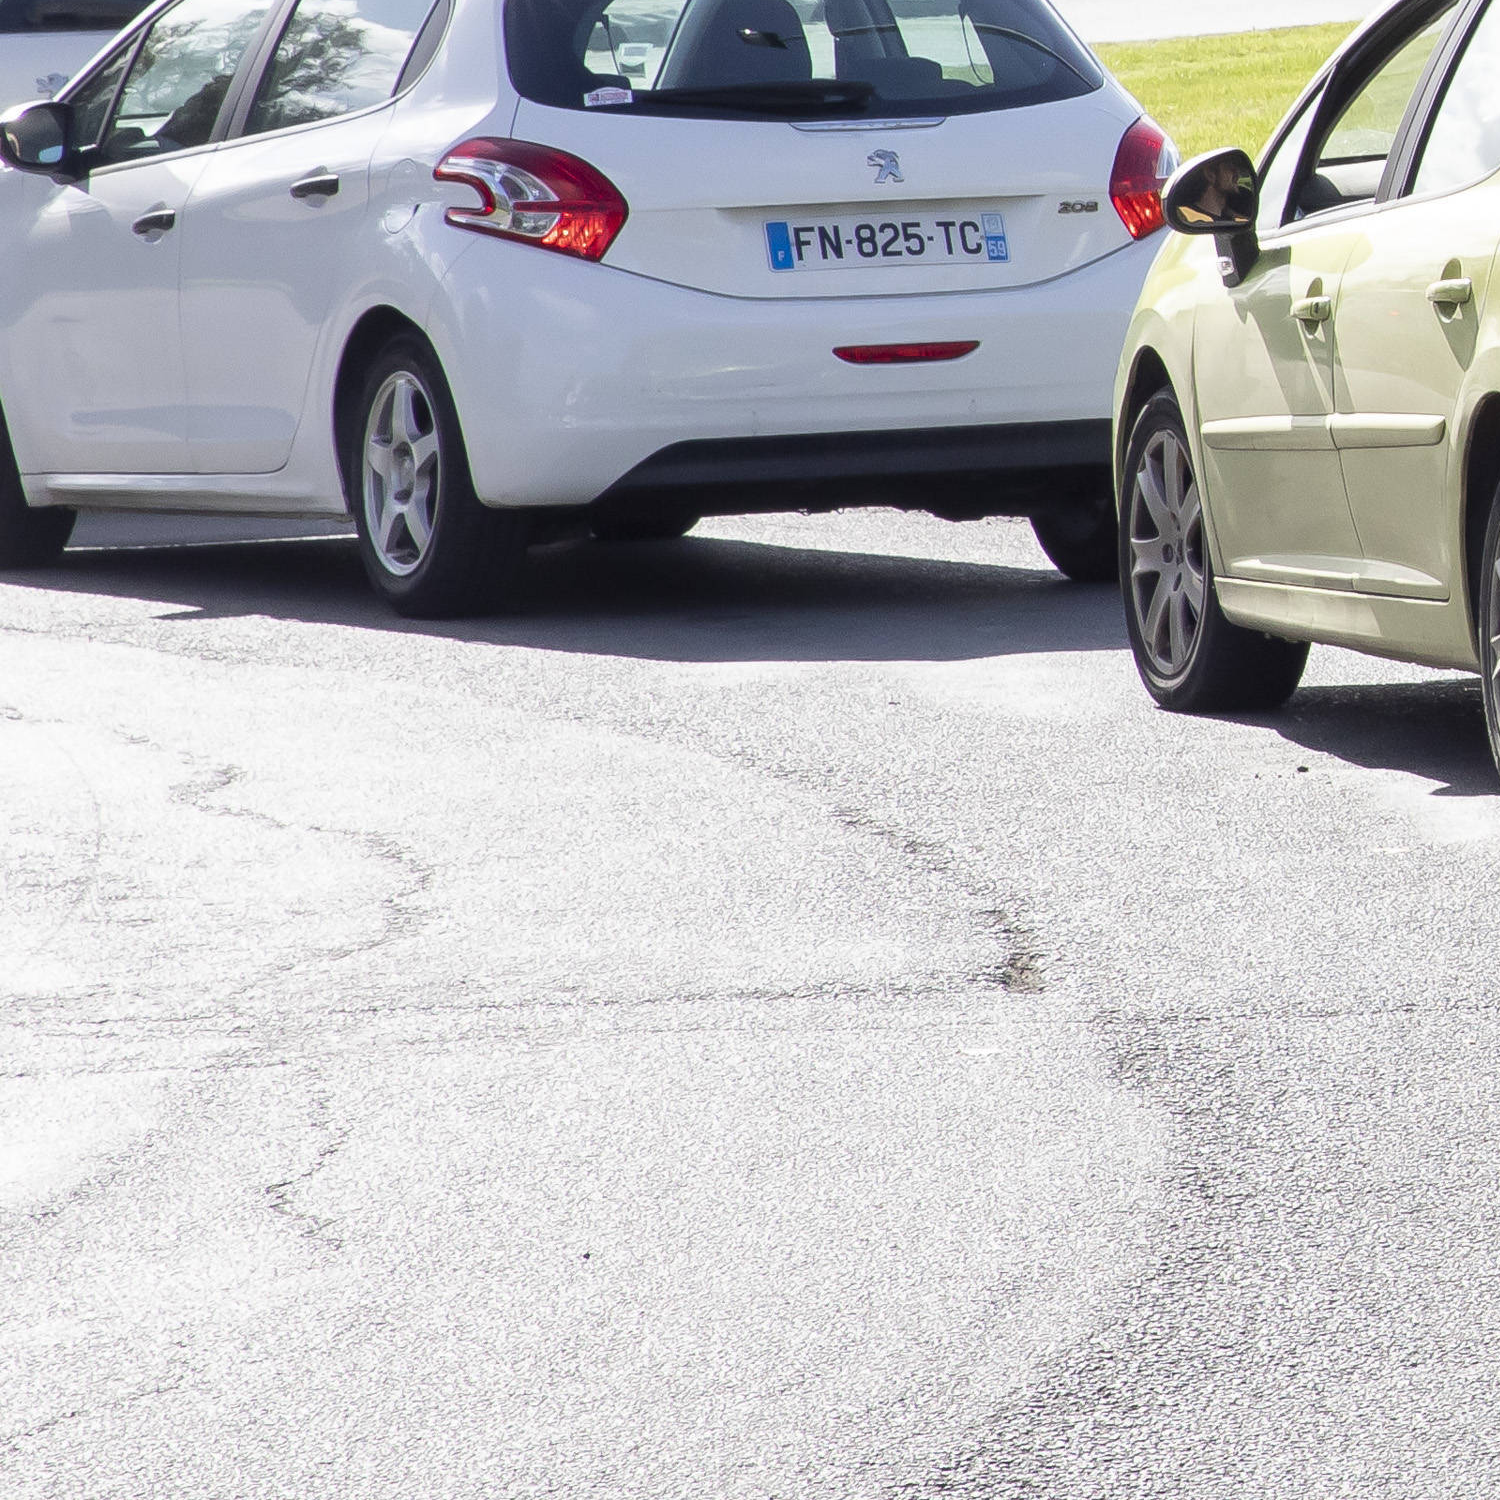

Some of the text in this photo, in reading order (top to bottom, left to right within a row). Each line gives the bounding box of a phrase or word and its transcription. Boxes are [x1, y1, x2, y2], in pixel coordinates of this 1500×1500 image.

[1058, 201, 1099, 214] 208
[793, 220, 983, 262] FN-825-TC
[988, 240, 1006, 257] 59
